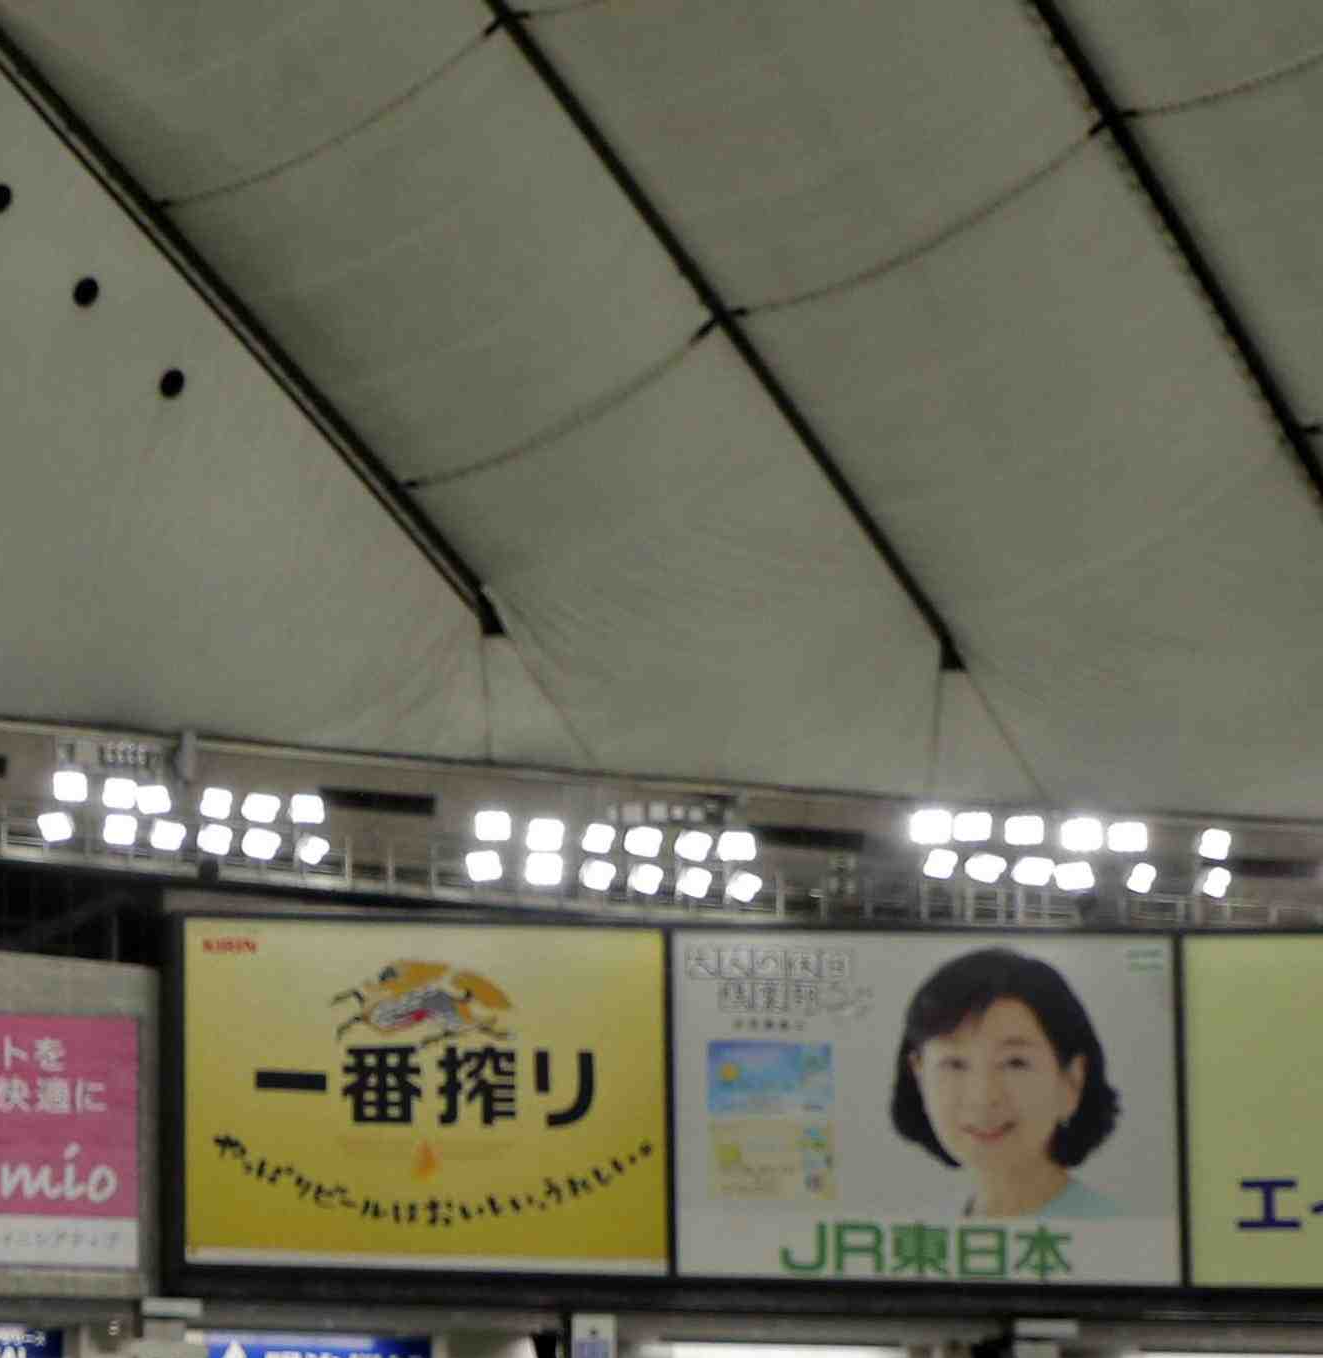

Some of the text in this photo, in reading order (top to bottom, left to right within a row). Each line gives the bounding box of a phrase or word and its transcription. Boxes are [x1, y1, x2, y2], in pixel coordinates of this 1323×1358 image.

[255, 1045, 595, 1127] 一番搾り
[779, 1222, 1073, 1278] JR東日本
